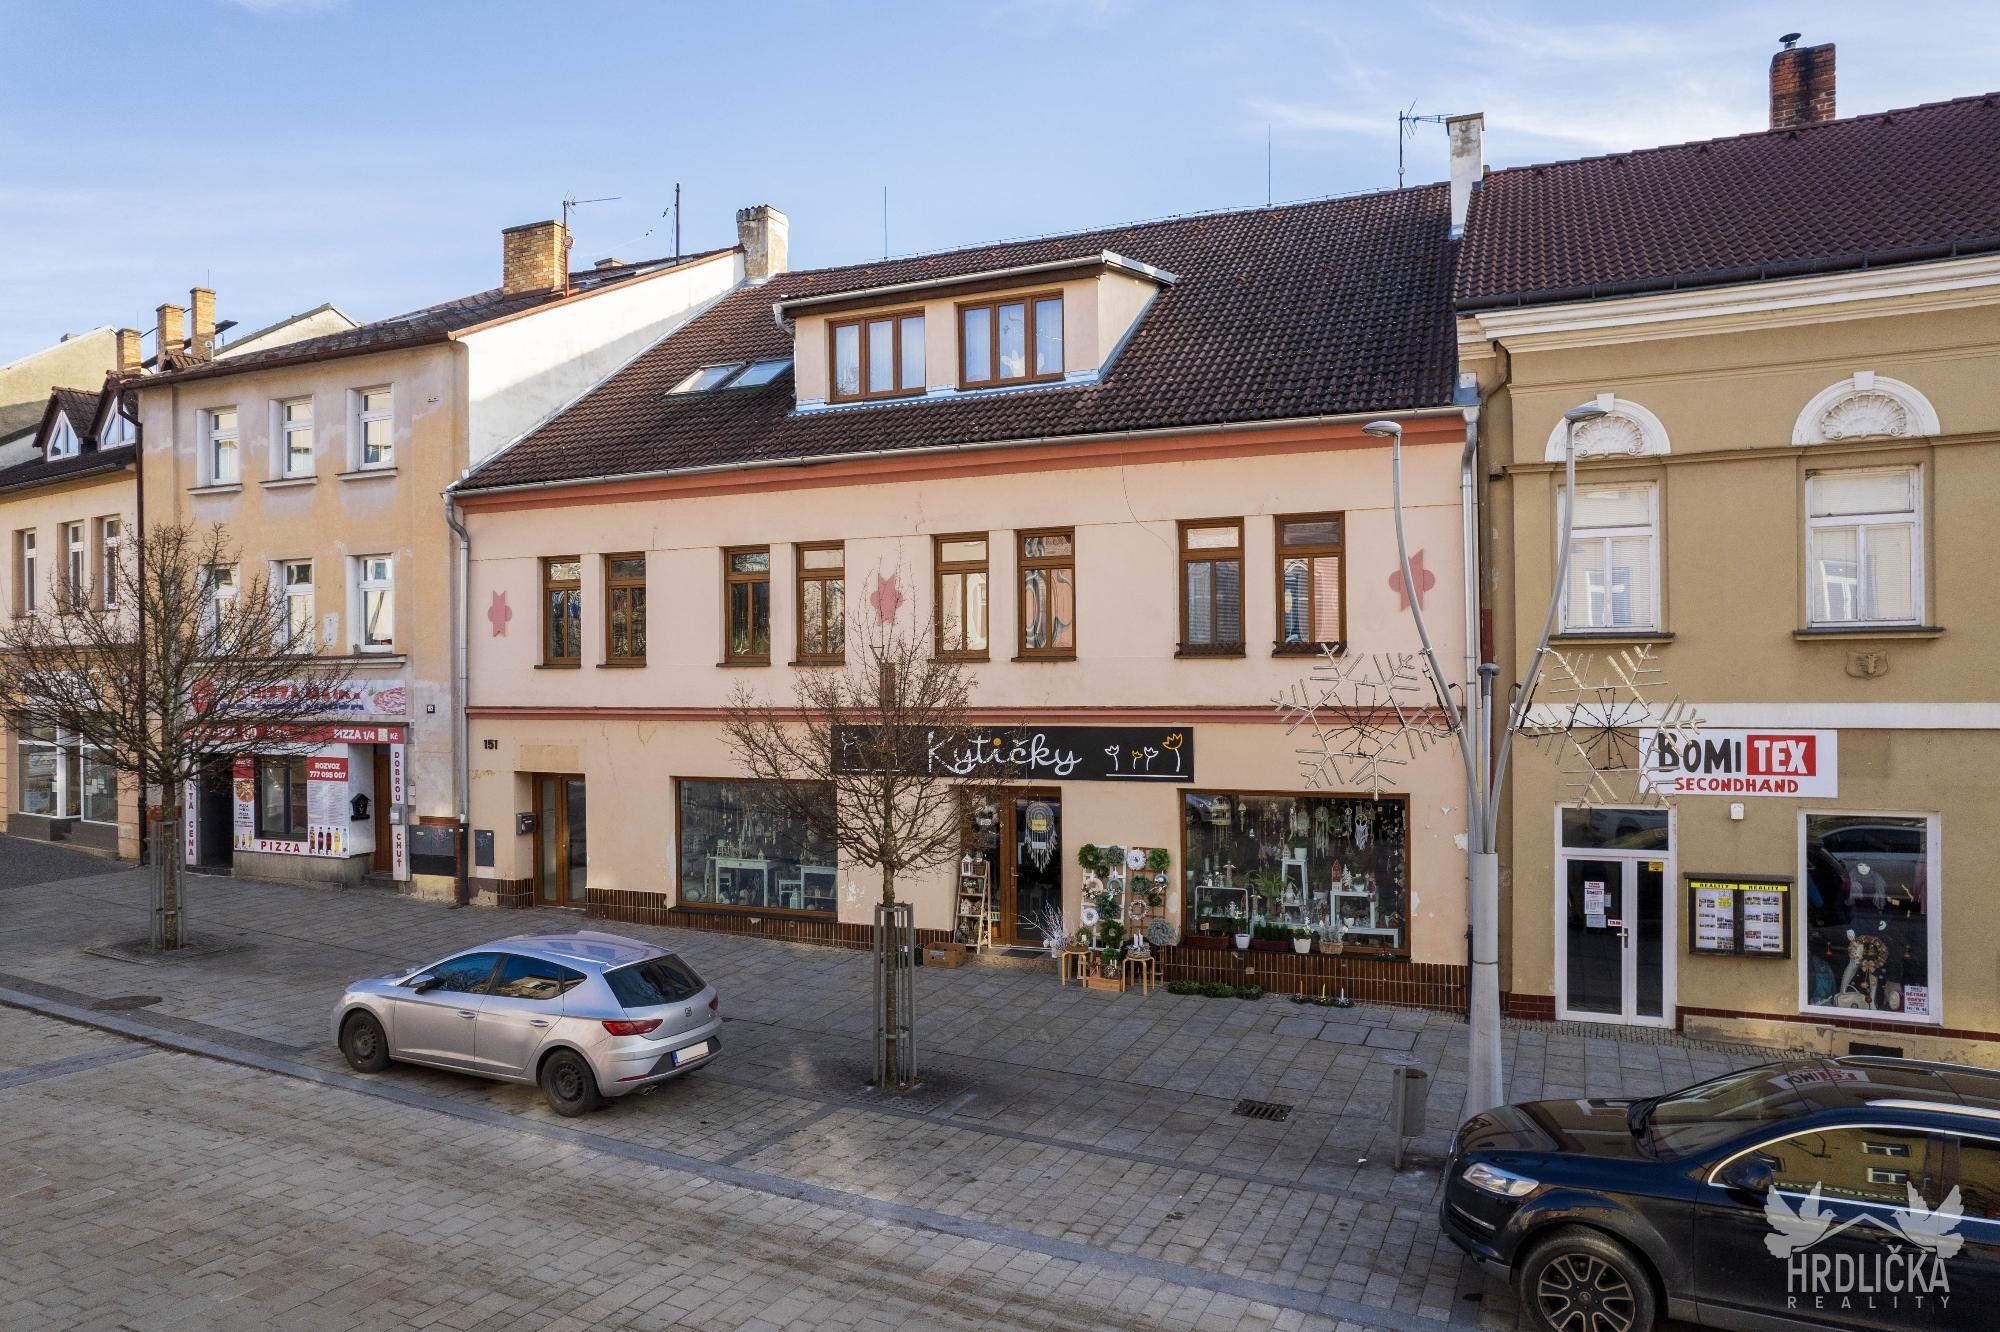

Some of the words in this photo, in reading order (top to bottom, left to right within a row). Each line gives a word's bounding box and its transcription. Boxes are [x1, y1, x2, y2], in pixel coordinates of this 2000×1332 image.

[334, 728, 361, 740] PIZZA
[363, 730, 375, 740] 1/4
[483, 739, 498, 750] 151
[927, 730, 1083, 776] Kytičky
[1657, 732, 1742, 774] BOMI
[1753, 739, 1808, 774] TEX
[314, 762, 341, 770] ROZVOZ
[309, 770, 321, 778] 777
[1674, 777, 1799, 793] SECONDHAND
[260, 841, 301, 853] PIZZA
